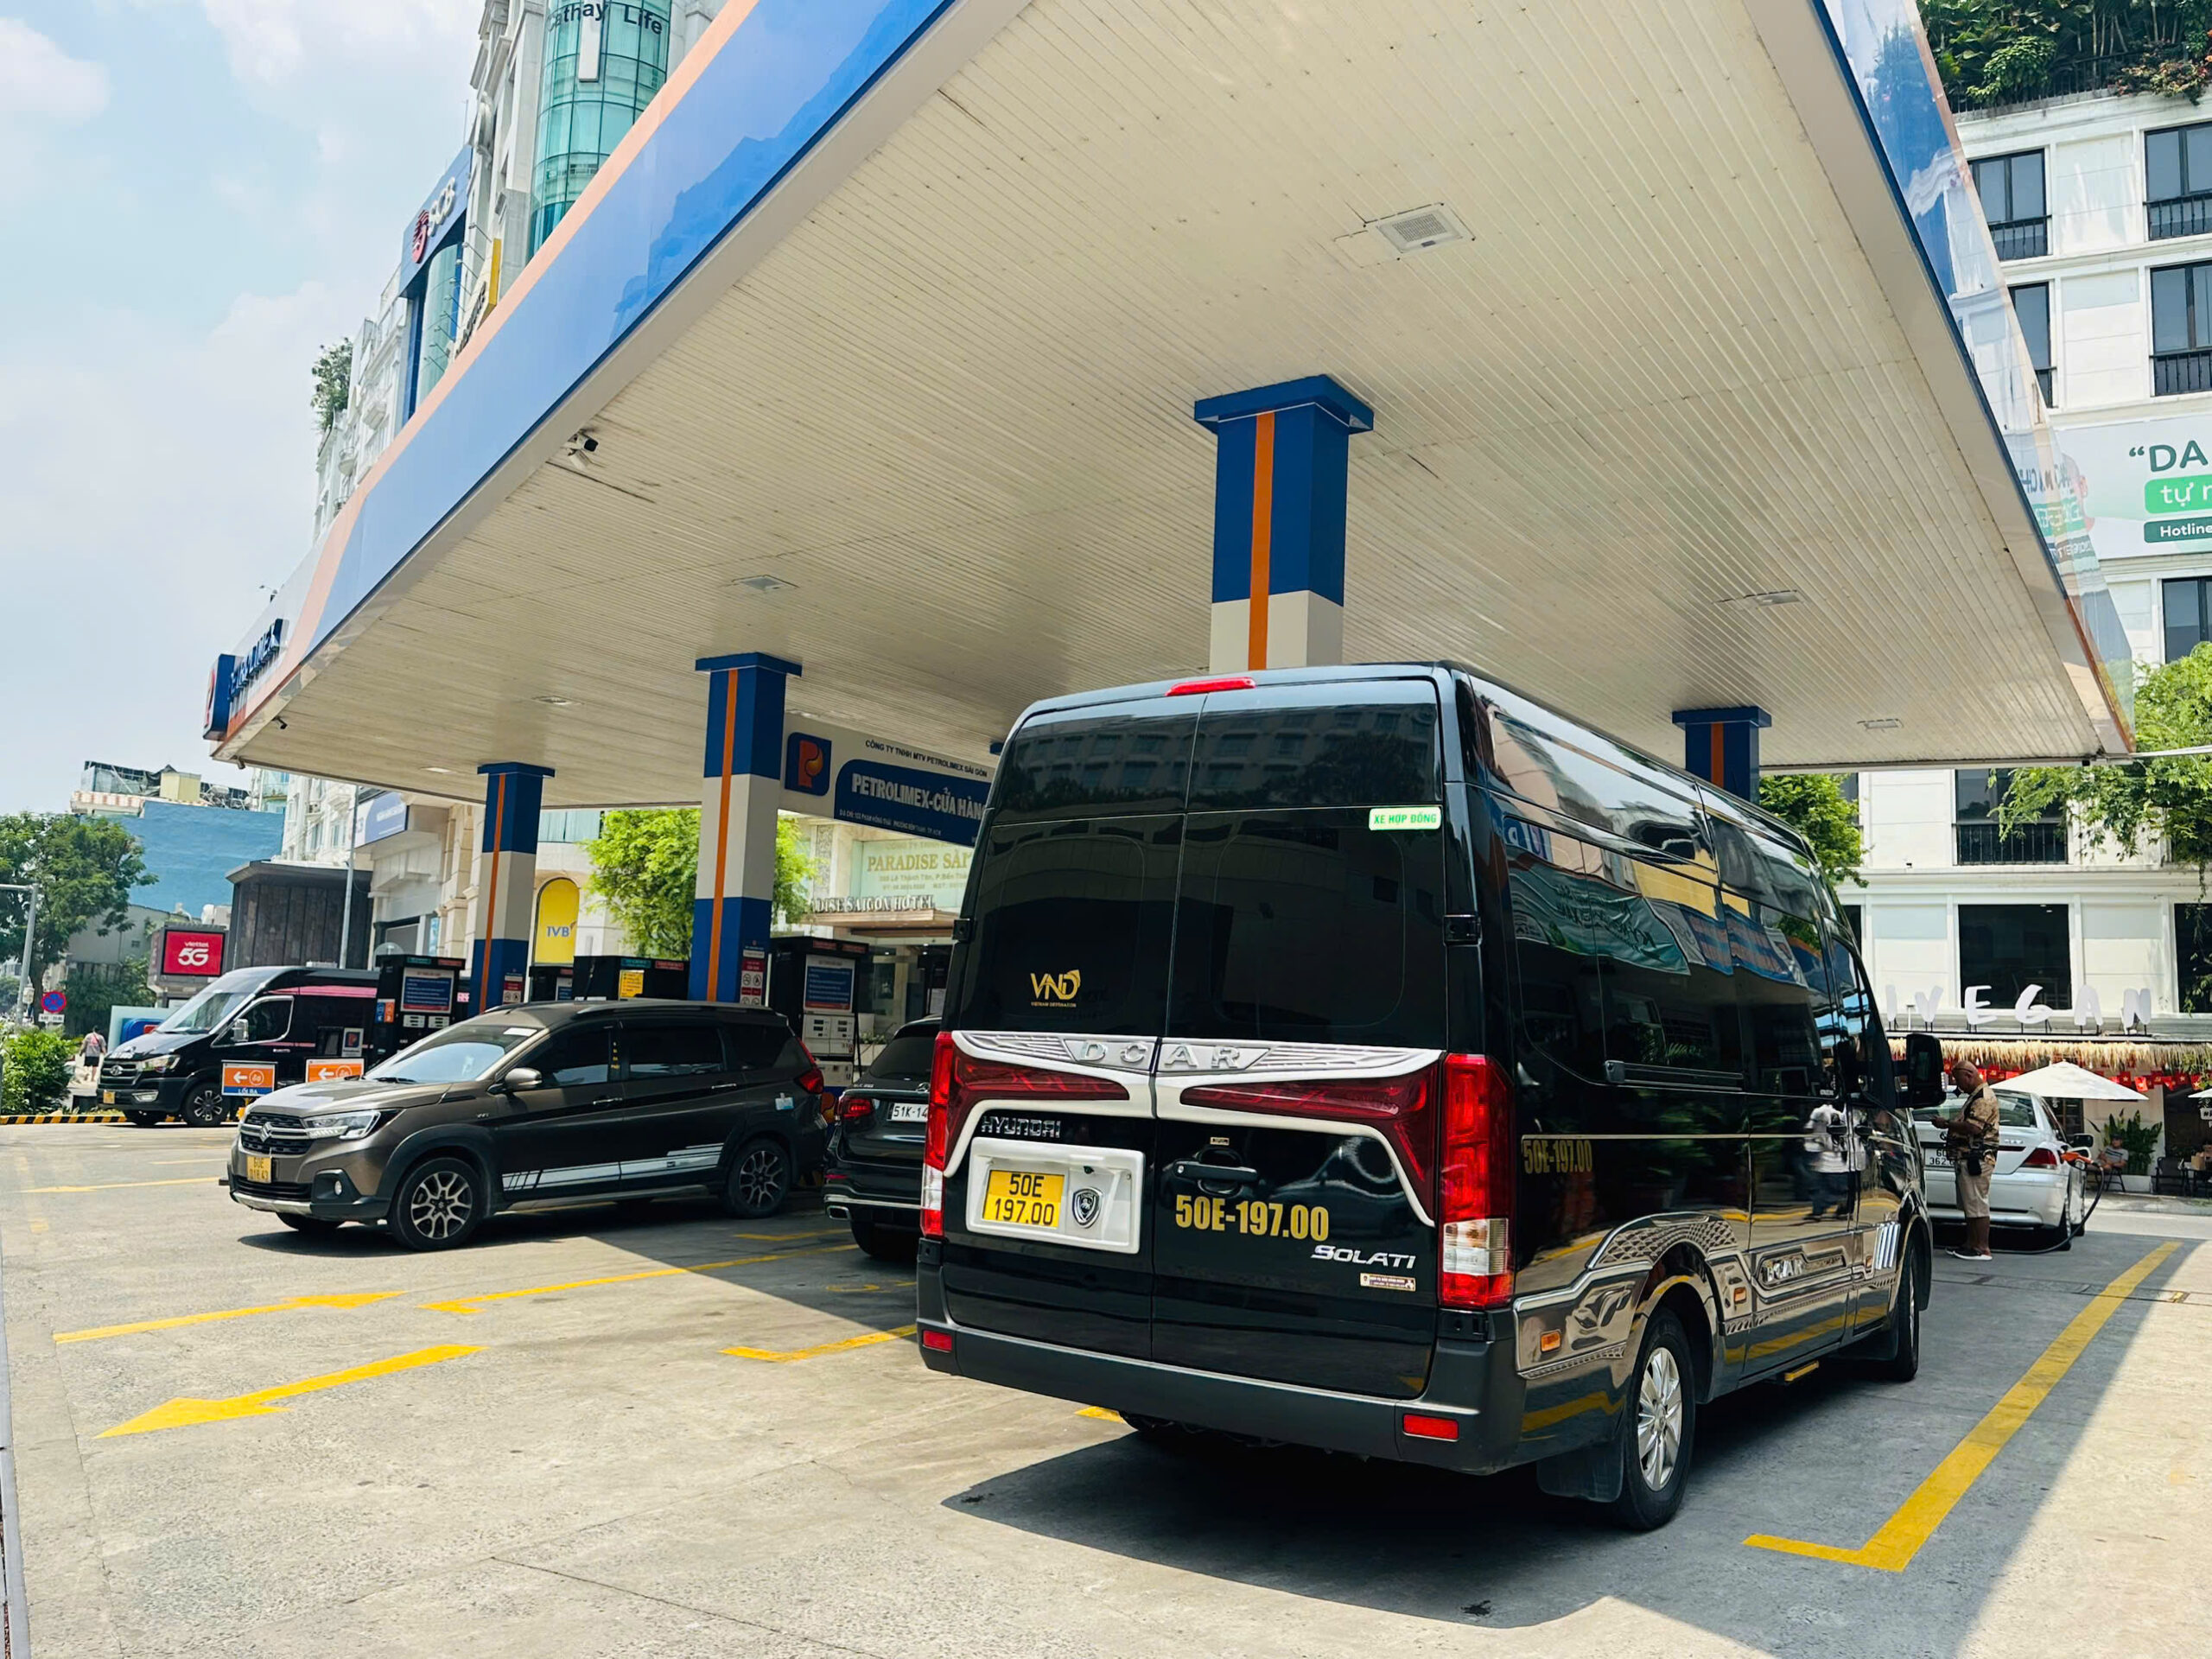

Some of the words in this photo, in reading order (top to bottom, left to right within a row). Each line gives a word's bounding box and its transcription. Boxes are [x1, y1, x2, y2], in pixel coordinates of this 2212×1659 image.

[624, 5, 663, 35] Life
[2160, 482, 2195, 507] tự
[865, 739, 885, 752] CÔNG
[886, 745, 894, 753] TY
[895, 747, 912, 759] TNHH
[926, 755, 964, 772] PETROLIMEX
[851, 772, 957, 816] PETROLIMEX-CỬA
[1374, 814, 1386, 824] XE
[867, 853, 938, 872] PARADISE
[178, 948, 209, 966] 5G
[1080, 1040, 1241, 1069] DCAR
[981, 1116, 1061, 1138] HYUNDAI
[1523, 1139, 1593, 1173] 50E-197.00
[1009, 1173, 1042, 1198] 50E
[995, 1198, 1055, 1226] 197.00
[1175, 1194, 1330, 1242] 50E-197.00
[1310, 1244, 1417, 1269] SOLATI
